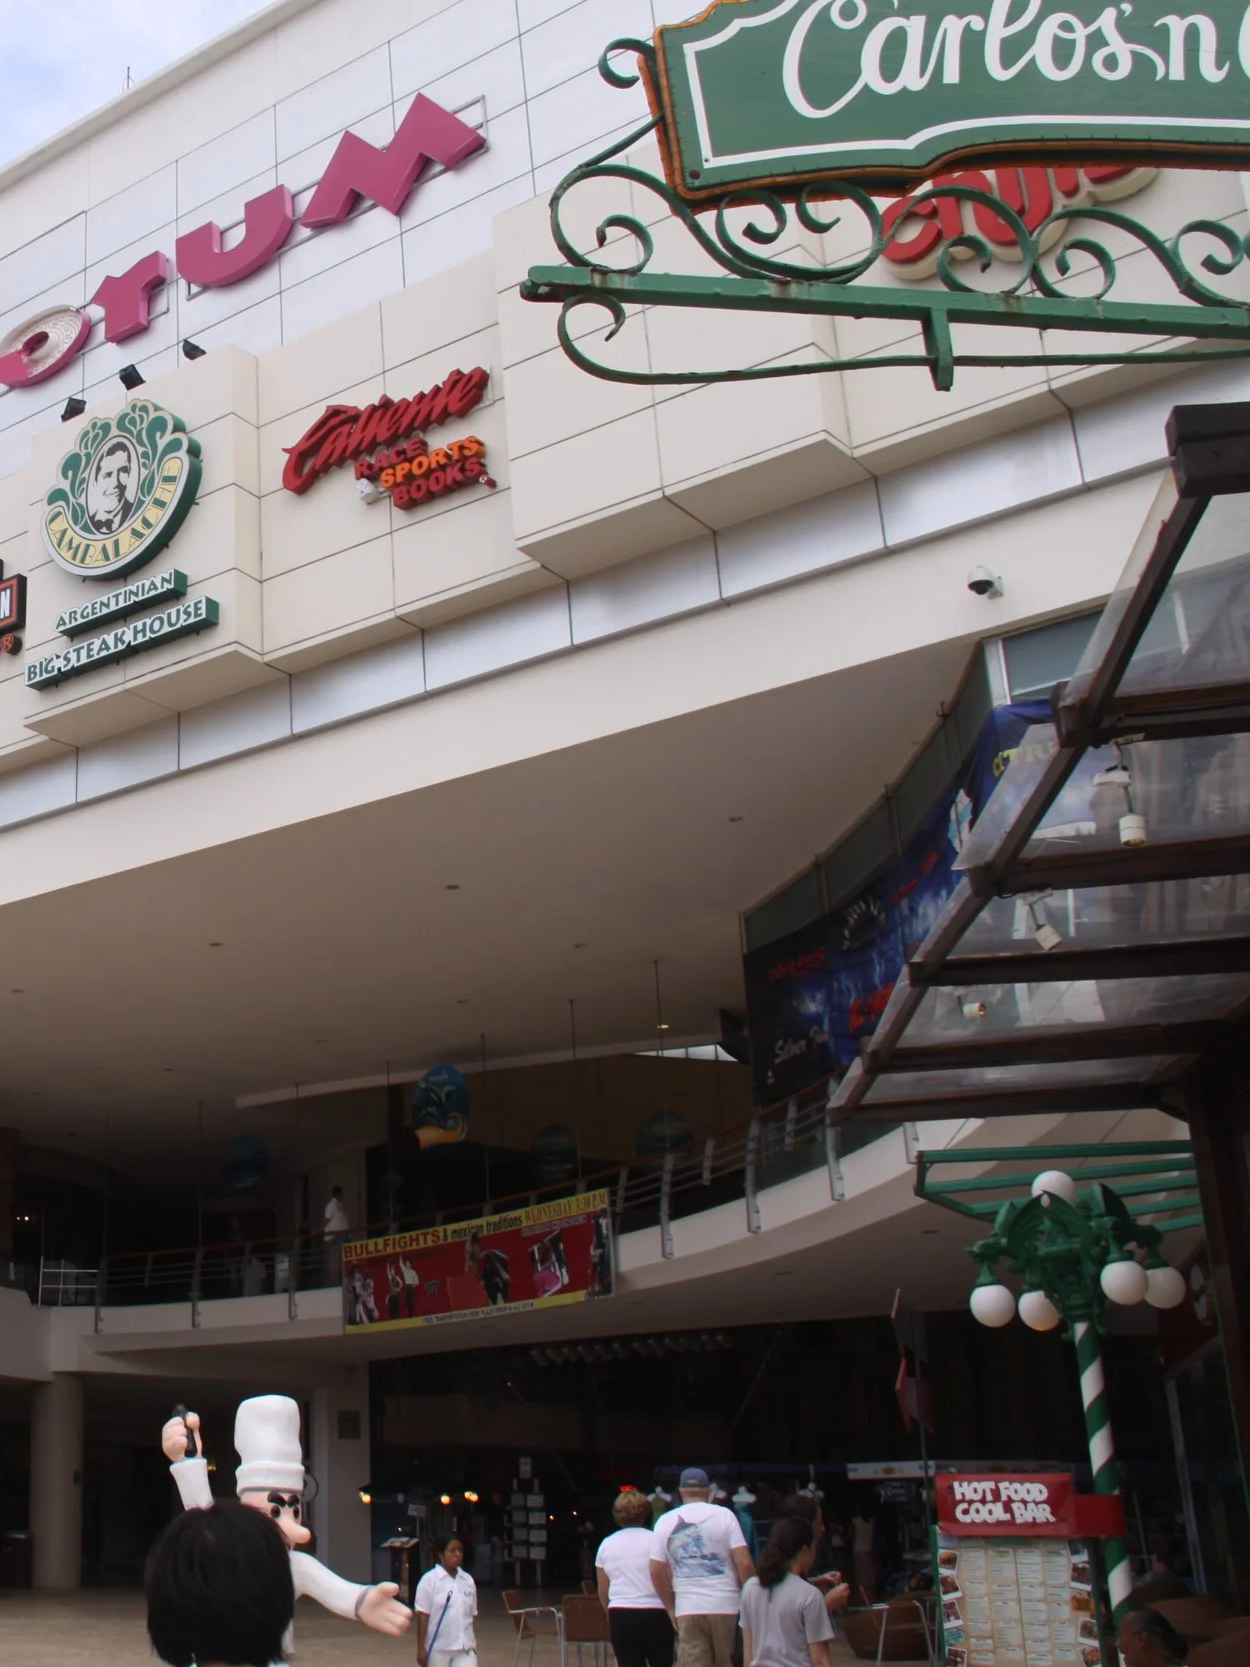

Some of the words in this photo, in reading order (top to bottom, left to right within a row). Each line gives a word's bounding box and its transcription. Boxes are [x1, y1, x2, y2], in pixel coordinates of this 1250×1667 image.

[281, 366, 489, 495] Caliente
[354, 436, 429, 480] RACE
[380, 435, 486, 489] SPORTS
[394, 457, 487, 511] BOOKS
[55, 571, 174, 630] ARGENTINIAN
[27, 658, 56, 683] BIG
[62, 630, 127, 671] STEAK
[132, 599, 204, 644] HOUSE
[344, 1230, 441, 1258] BULLFIGHTS
[486, 1214, 522, 1233] traditions
[524, 1200, 572, 1221] WEDNESDAY
[952, 1480, 996, 1502] HOT
[998, 1481, 1048, 1502] FOOD
[955, 1502, 1010, 1524] COOL
[1011, 1503, 1057, 1524] BAR
